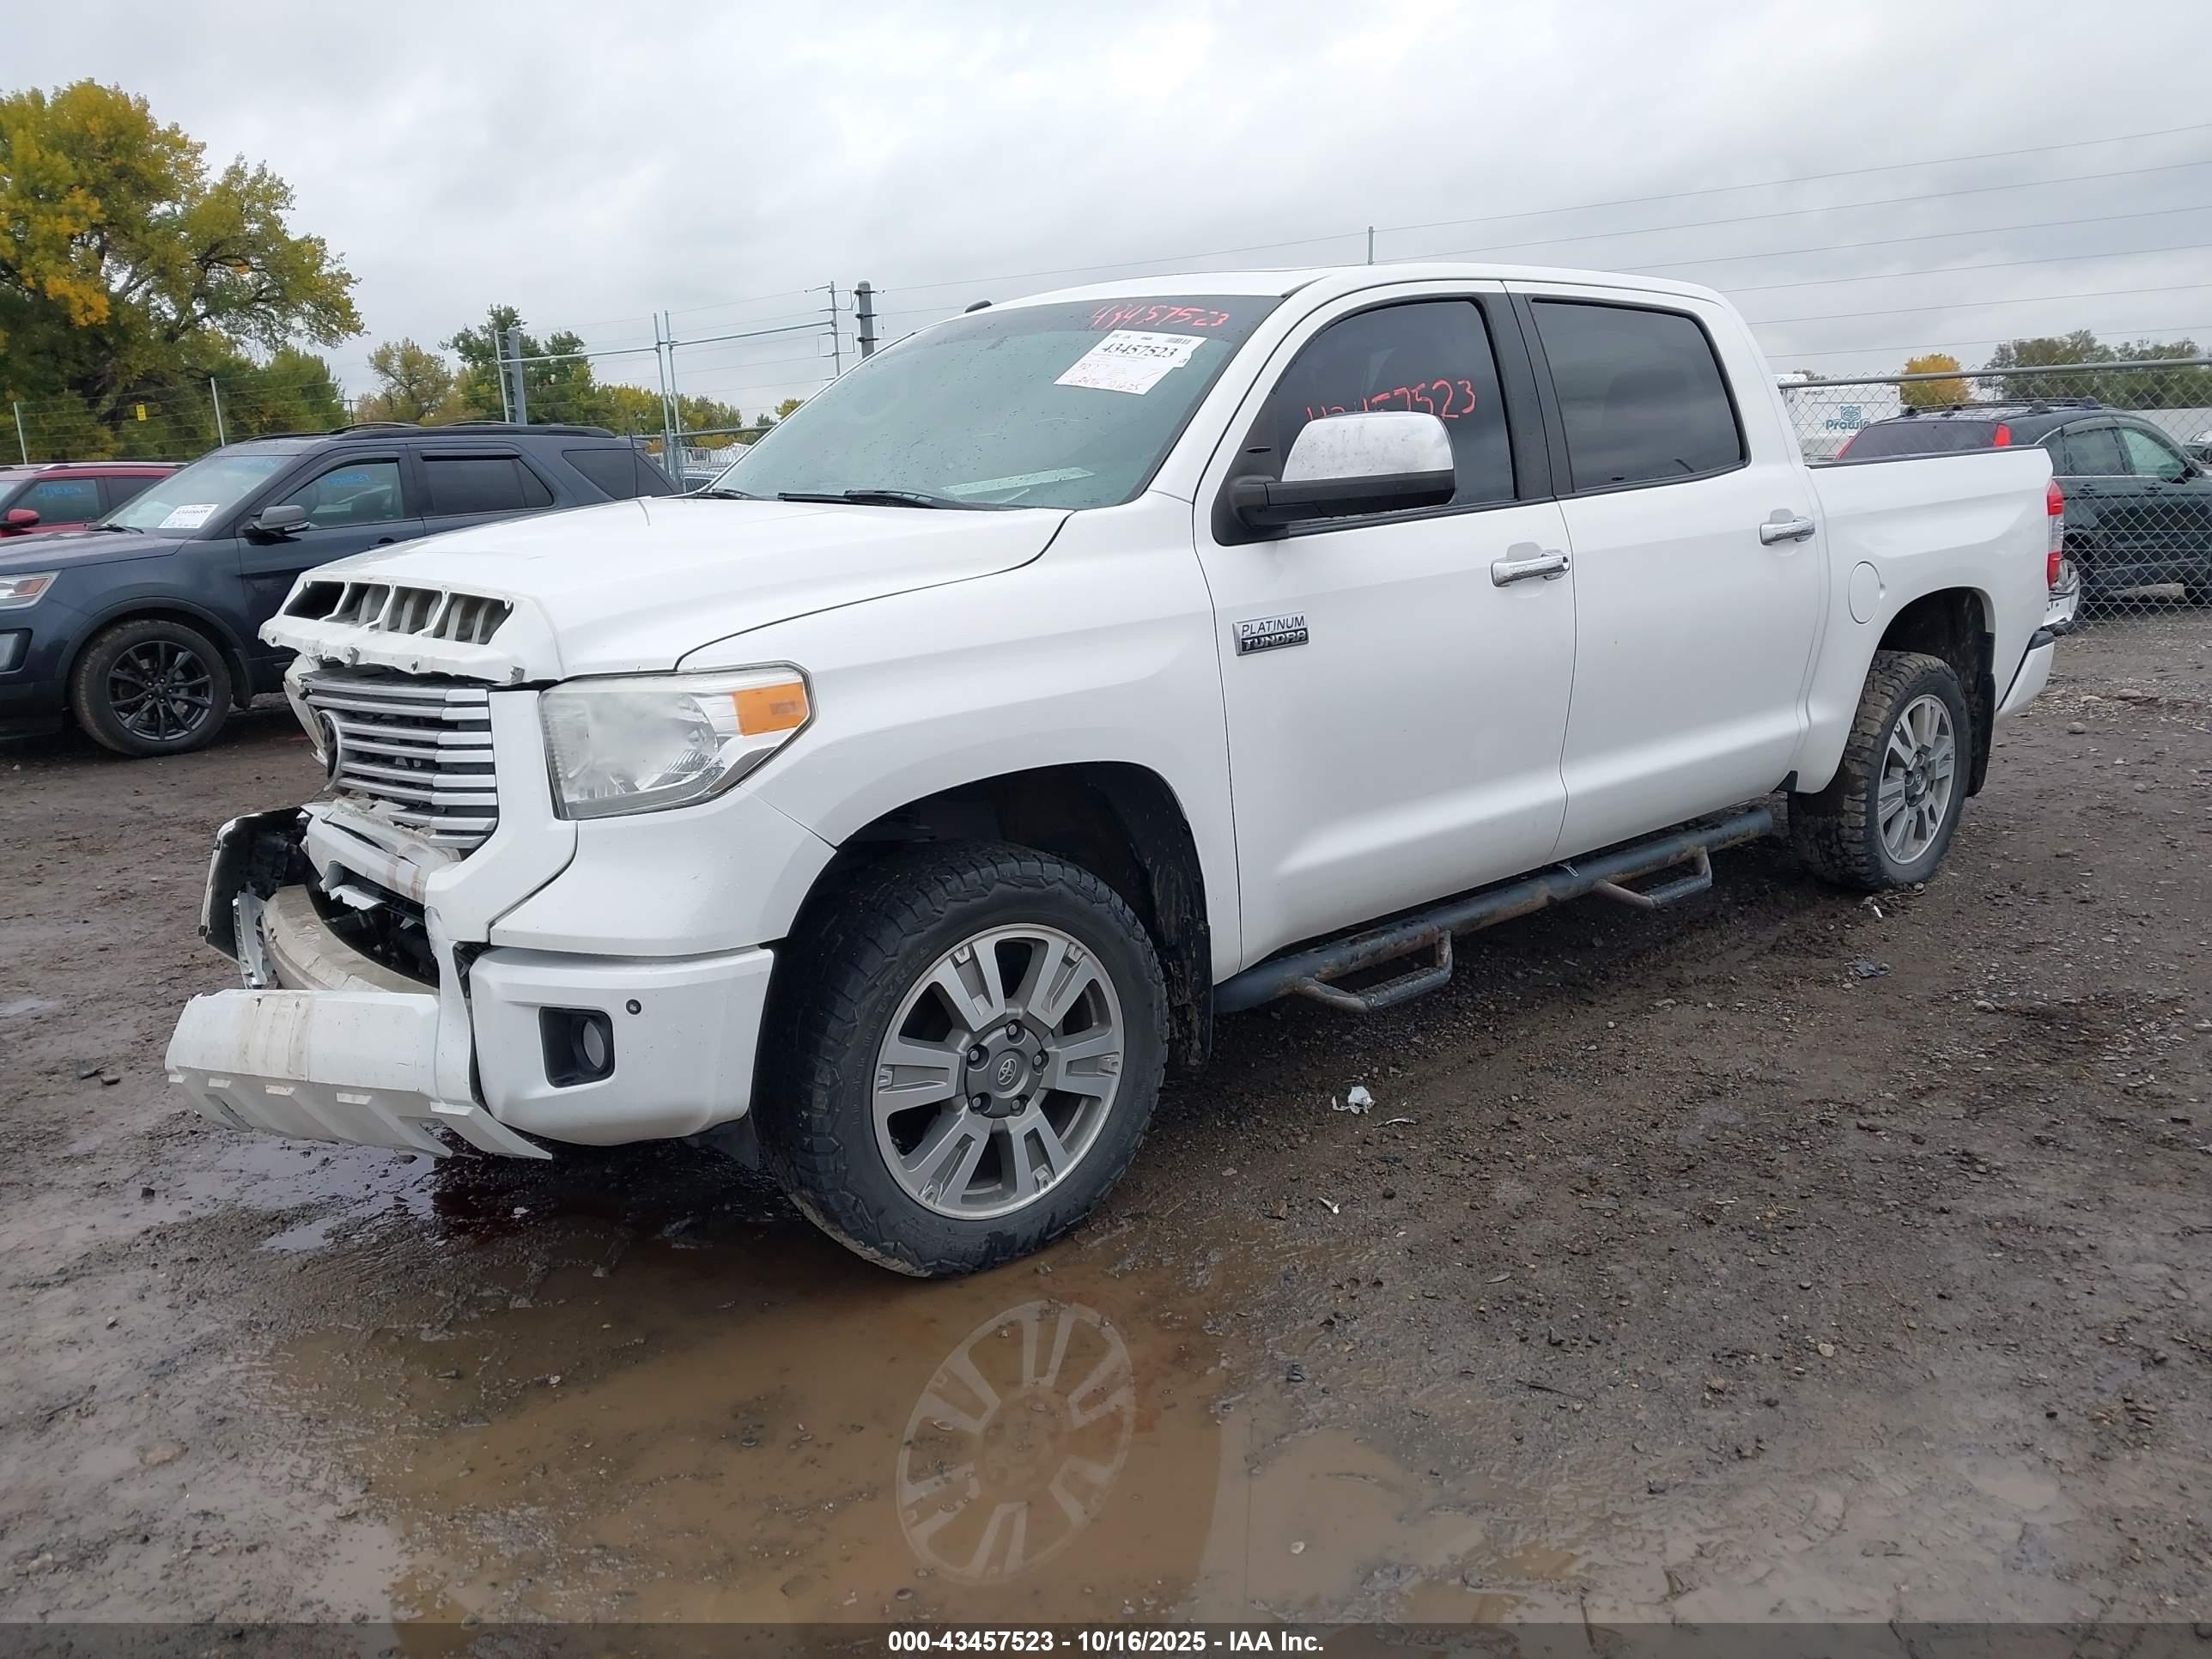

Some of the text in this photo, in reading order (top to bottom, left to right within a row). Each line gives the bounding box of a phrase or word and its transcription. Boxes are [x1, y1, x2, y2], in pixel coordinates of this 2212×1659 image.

[1092, 303, 1230, 331] 43457523
[1102, 343, 1178, 358] 43457523
[1242, 616, 1305, 635] PLATINUM
[1243, 629, 1306, 650] TUNDRA
